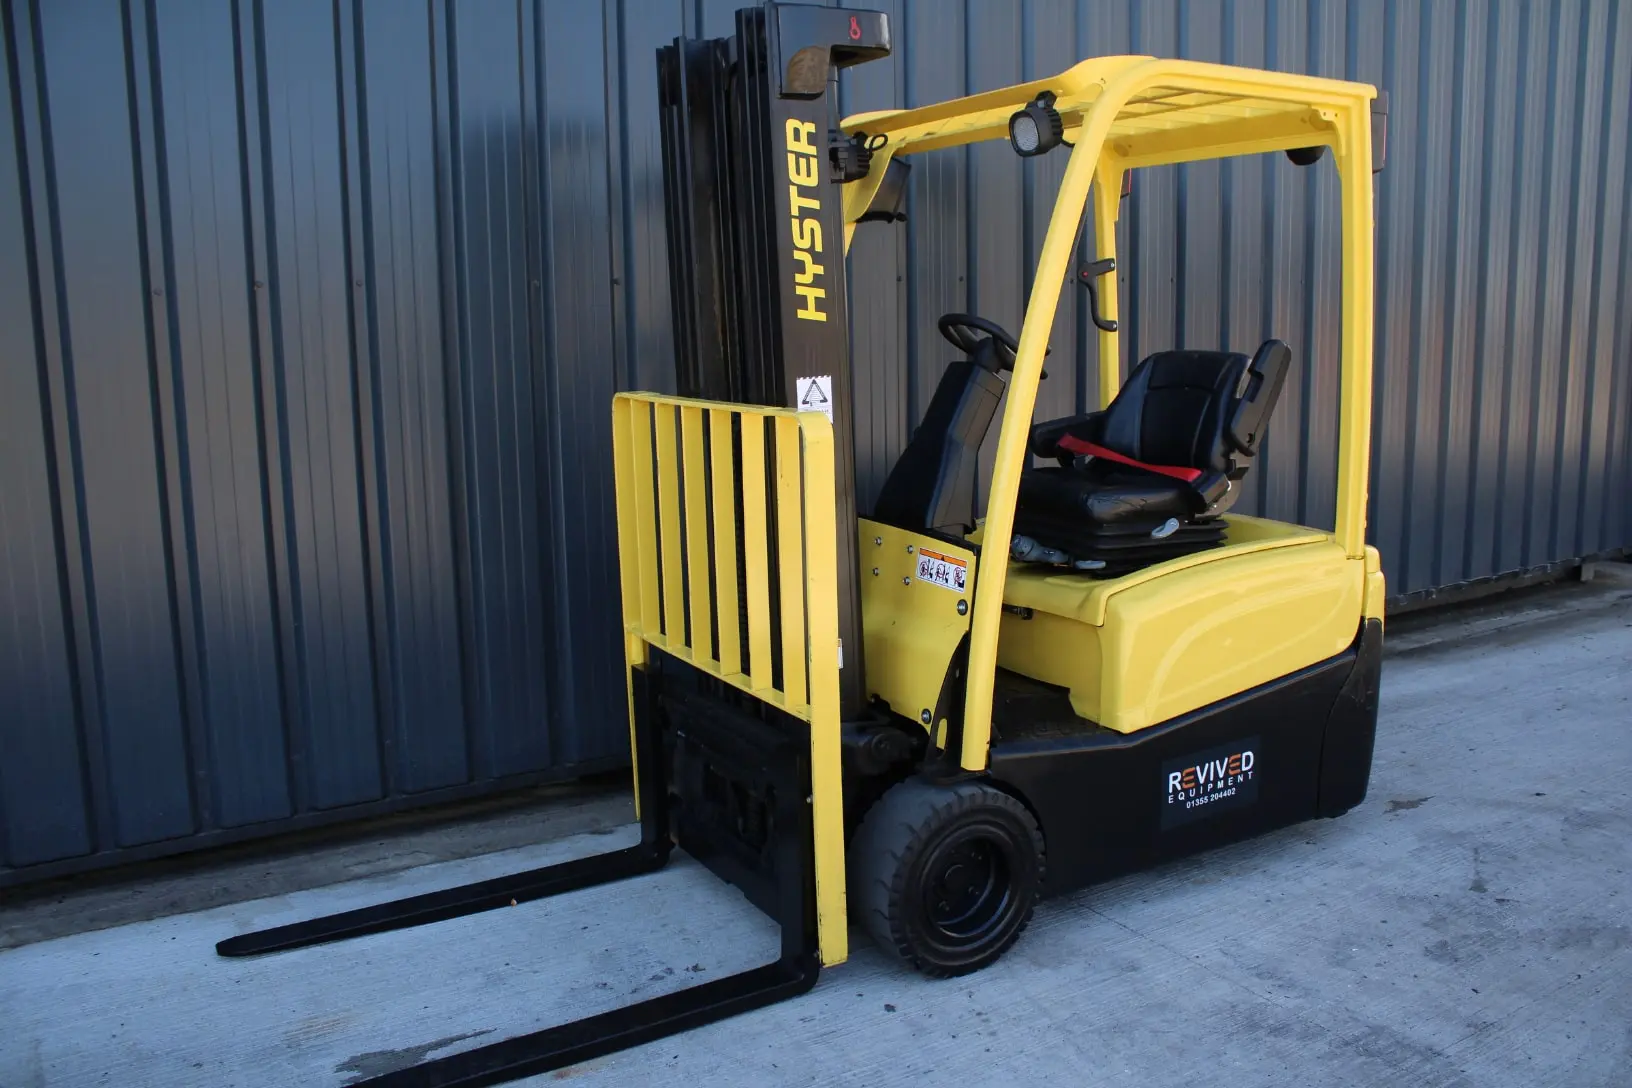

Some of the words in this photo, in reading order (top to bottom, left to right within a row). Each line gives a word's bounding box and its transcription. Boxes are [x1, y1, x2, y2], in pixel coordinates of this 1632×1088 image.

[785, 118, 827, 322] HYSTER
[1168, 751, 1255, 794] REVIVED
[1168, 771, 1254, 804] EQUIPMENT
[1186, 796, 1209, 809] 01355
[1210, 787, 1236, 802] 204402
